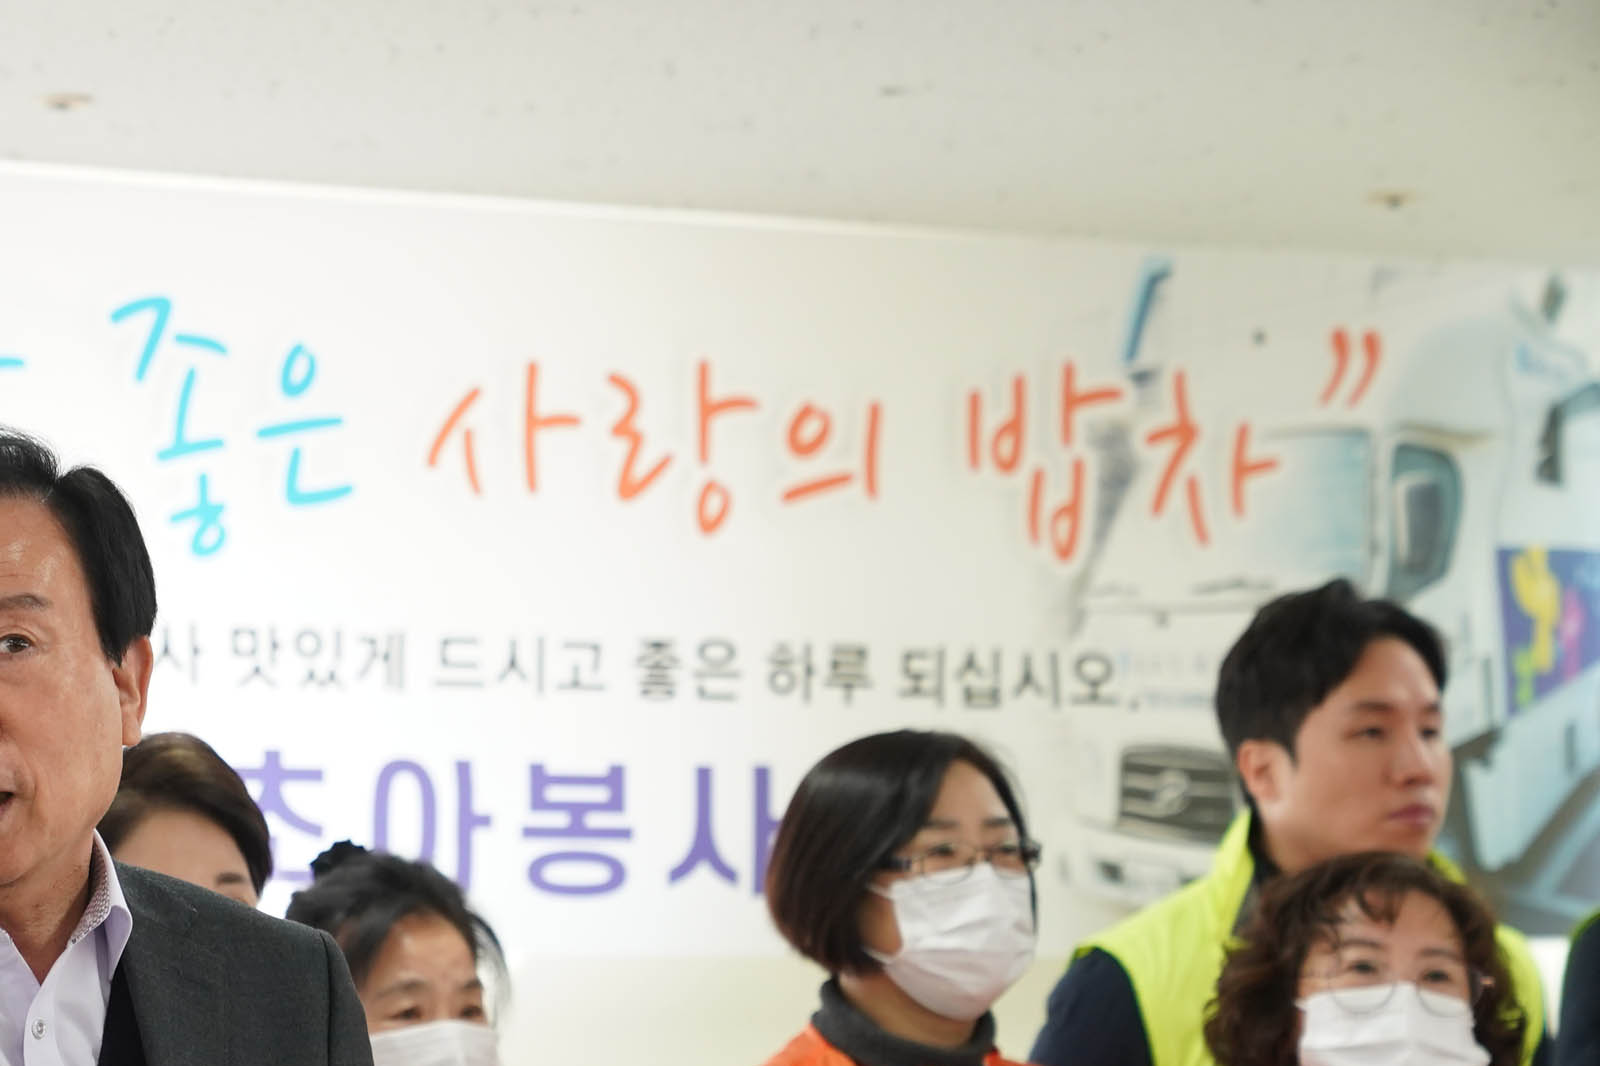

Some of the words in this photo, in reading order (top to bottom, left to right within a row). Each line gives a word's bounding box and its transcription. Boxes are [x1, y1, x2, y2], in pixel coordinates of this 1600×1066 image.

[111, 297, 355, 556] 좋은
[429, 361, 882, 534] 사랑의
[232, 626, 408, 690] 맛있게
[434, 634, 604, 697] 드시고
[636, 638, 742, 702] 좋은
[764, 642, 874, 706] 하루
